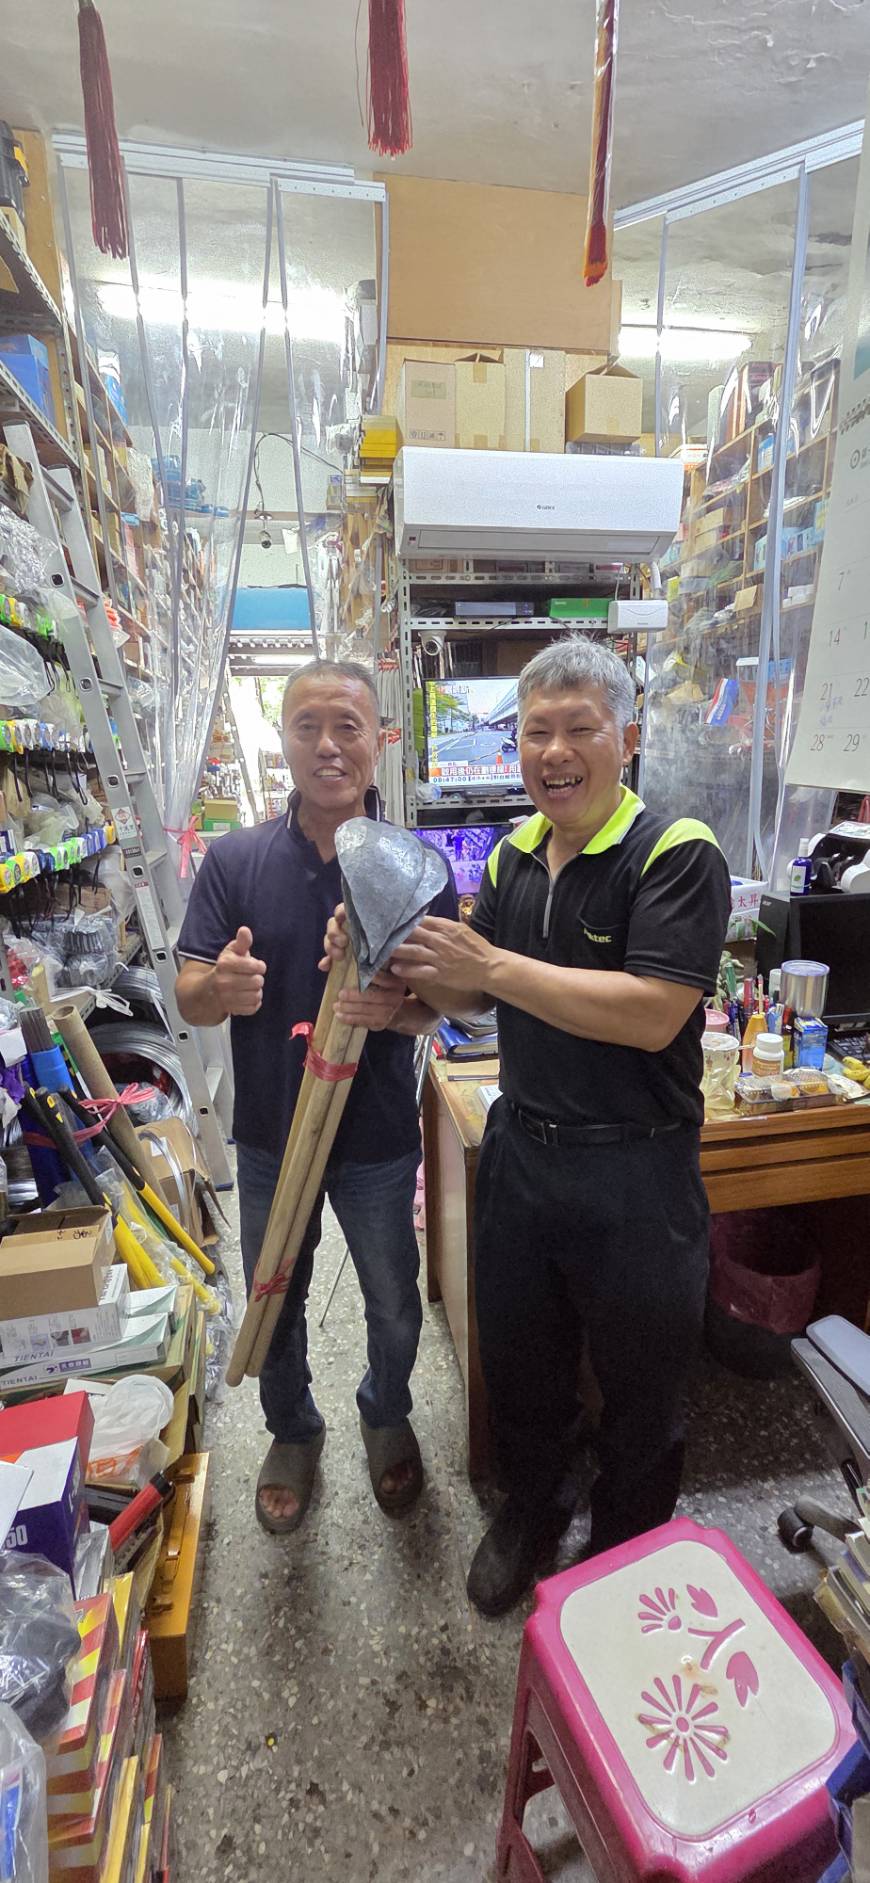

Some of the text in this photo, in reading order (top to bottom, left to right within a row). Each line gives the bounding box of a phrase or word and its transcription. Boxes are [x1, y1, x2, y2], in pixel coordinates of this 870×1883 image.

[838, 571, 845, 591] 7
[828, 628, 841, 647] 14
[820, 677, 870, 701] 21 22
[810, 733, 860, 752] 28 29
[15, 1351, 54, 1362] TIENTAI
[2, 1375, 38, 1386] TIENTAI
[2, 1525, 28, 1549] 50
